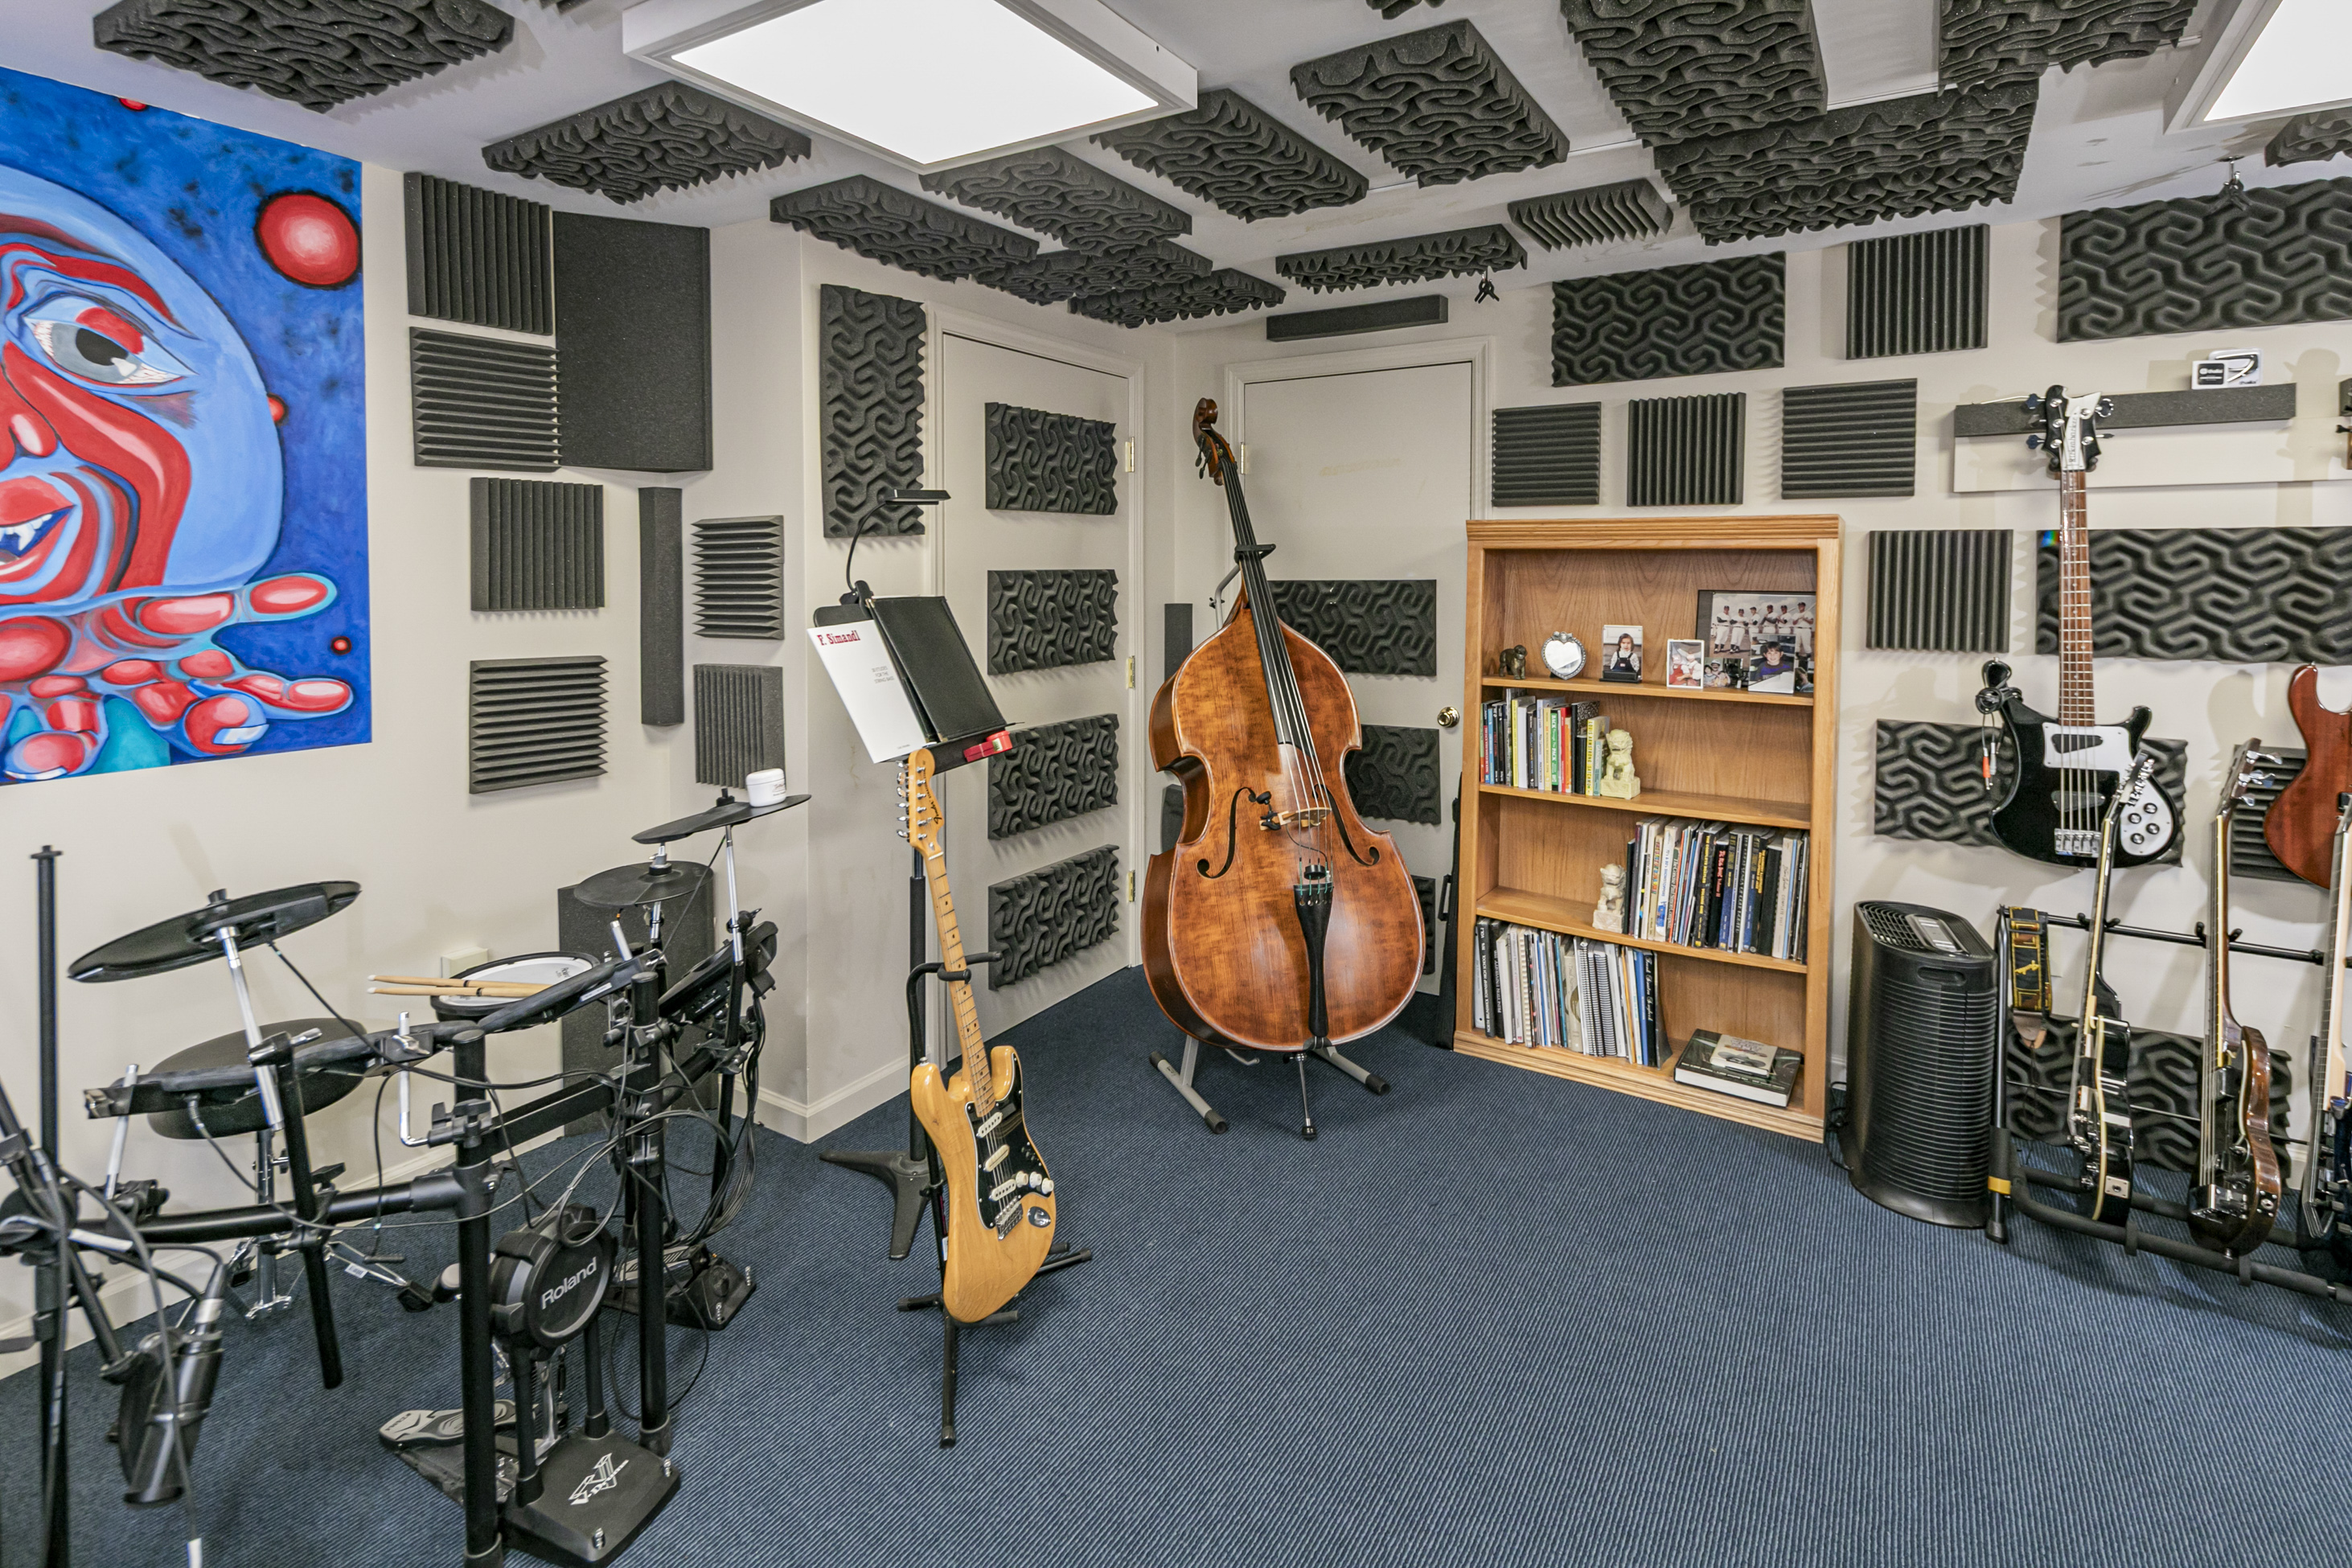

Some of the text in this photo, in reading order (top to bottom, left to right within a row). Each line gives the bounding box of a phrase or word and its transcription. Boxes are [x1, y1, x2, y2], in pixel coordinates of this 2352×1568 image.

[817, 630, 861, 646] F. Simandl
[930, 800, 942, 824] Fender
[1645, 975, 1653, 995] Sinatra
[541, 1256, 597, 1310] Roland
